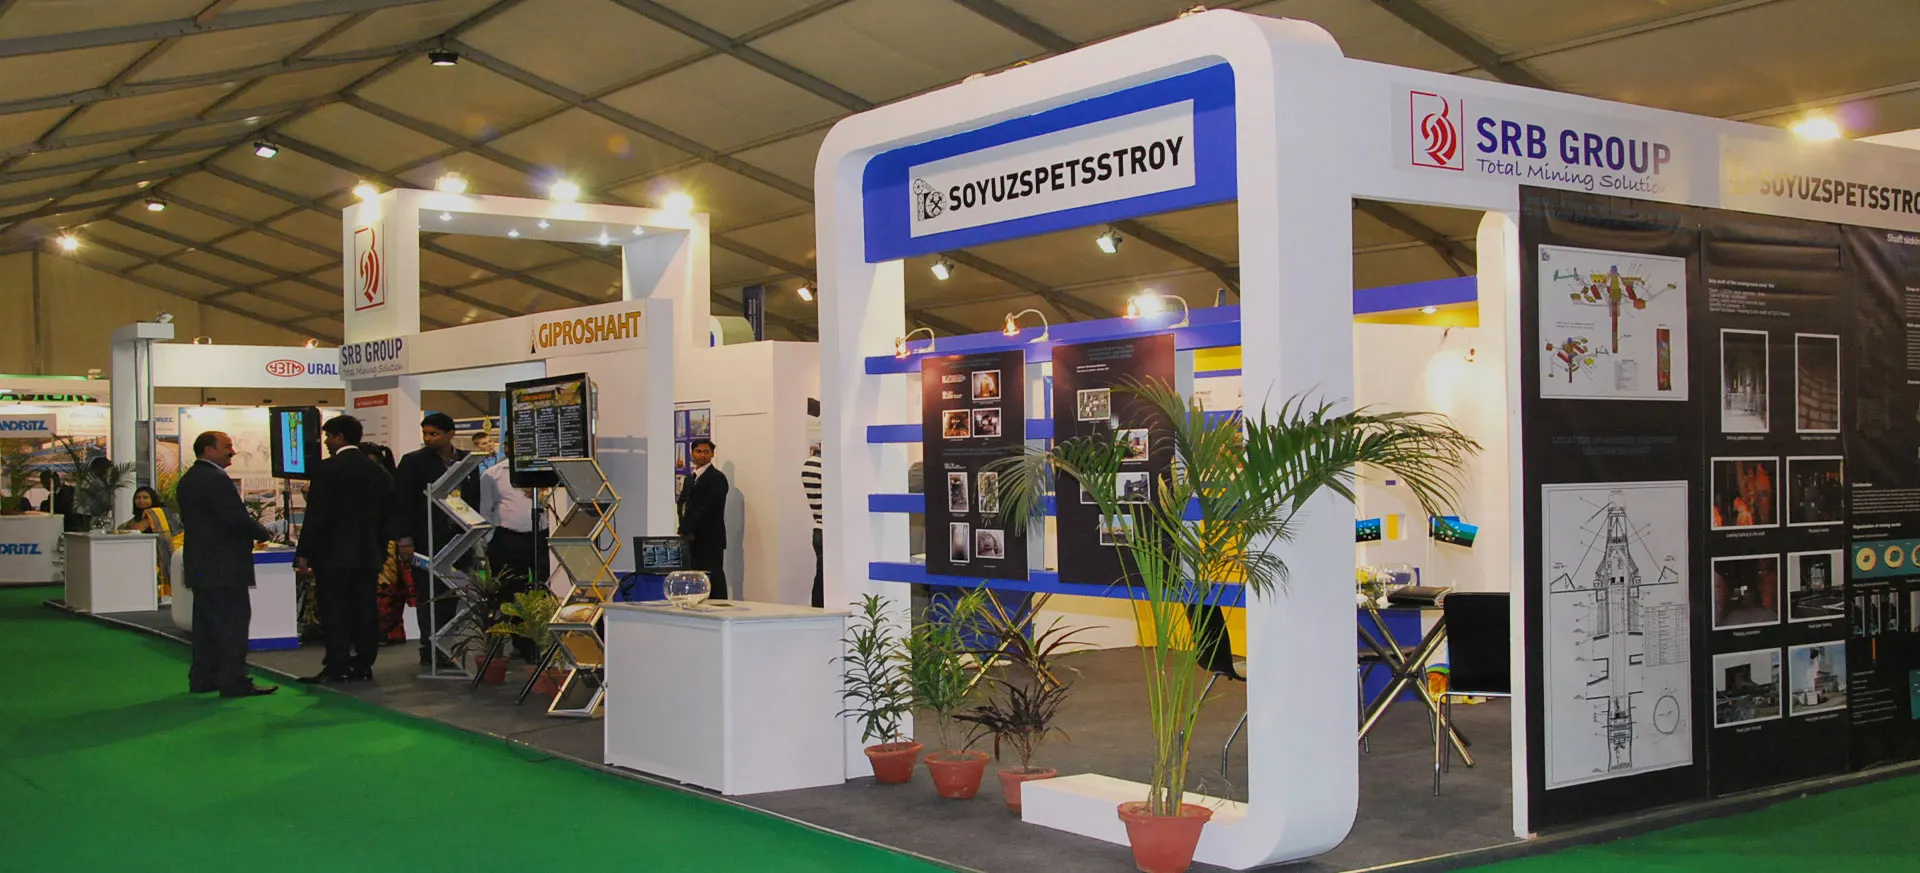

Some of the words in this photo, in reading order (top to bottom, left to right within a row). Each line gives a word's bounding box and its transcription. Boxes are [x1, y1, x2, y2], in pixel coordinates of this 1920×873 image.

[1476, 116, 1548, 159] SRB
[1559, 129, 1672, 175] GROUP
[948, 135, 1184, 212] SOYUZSPETSSTROY
[1476, 158, 1522, 177] Total
[1527, 162, 1595, 190] Mining
[538, 310, 642, 348] GIPROSHAHT
[307, 363, 338, 375] URAL
[341, 344, 362, 366] SRB
[365, 338, 403, 363] GROUP
